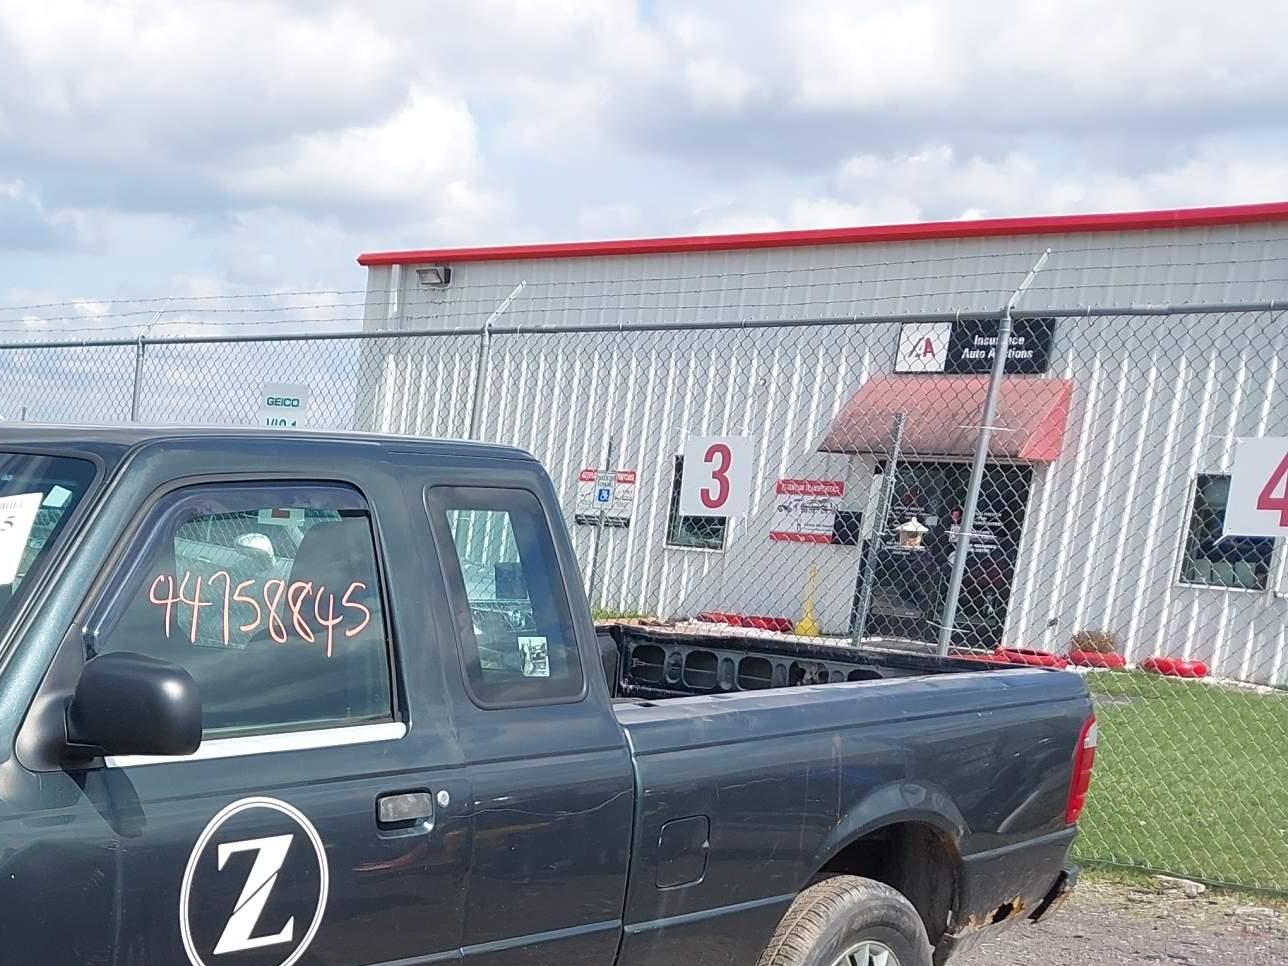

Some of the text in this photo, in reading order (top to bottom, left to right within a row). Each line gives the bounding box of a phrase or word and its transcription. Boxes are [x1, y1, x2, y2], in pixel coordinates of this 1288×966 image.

[961, 347, 1034, 359] Auto Ations
[974, 334, 1025, 346] Insuce
[266, 396, 300, 408] GEICO
[699, 443, 732, 509] 3
[1256, 450, 1288, 528] 4
[149, 570, 371, 659] 44758845
[213, 833, 295, 955] Z
